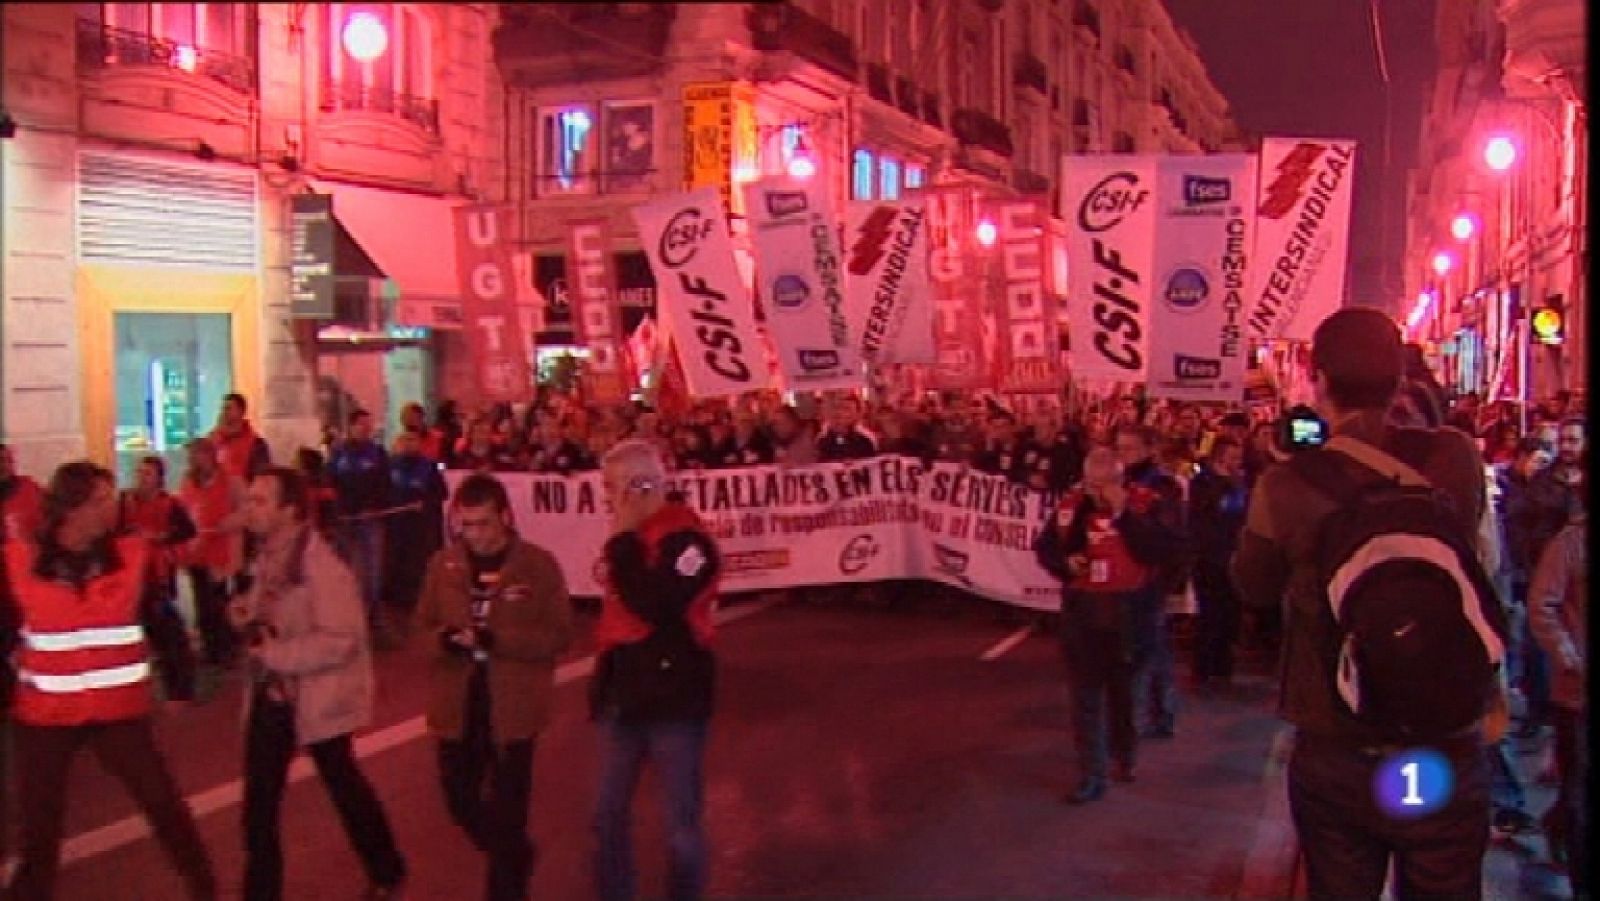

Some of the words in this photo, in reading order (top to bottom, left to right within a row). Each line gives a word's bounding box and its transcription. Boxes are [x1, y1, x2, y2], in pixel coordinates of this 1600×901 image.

[467, 211, 506, 351] UGT
[1248, 143, 1352, 335] INTERSINDICAL
[532, 480, 567, 514] NO
[576, 480, 597, 514] A
[835, 466, 872, 499] EN
[878, 458, 923, 494] ELS
